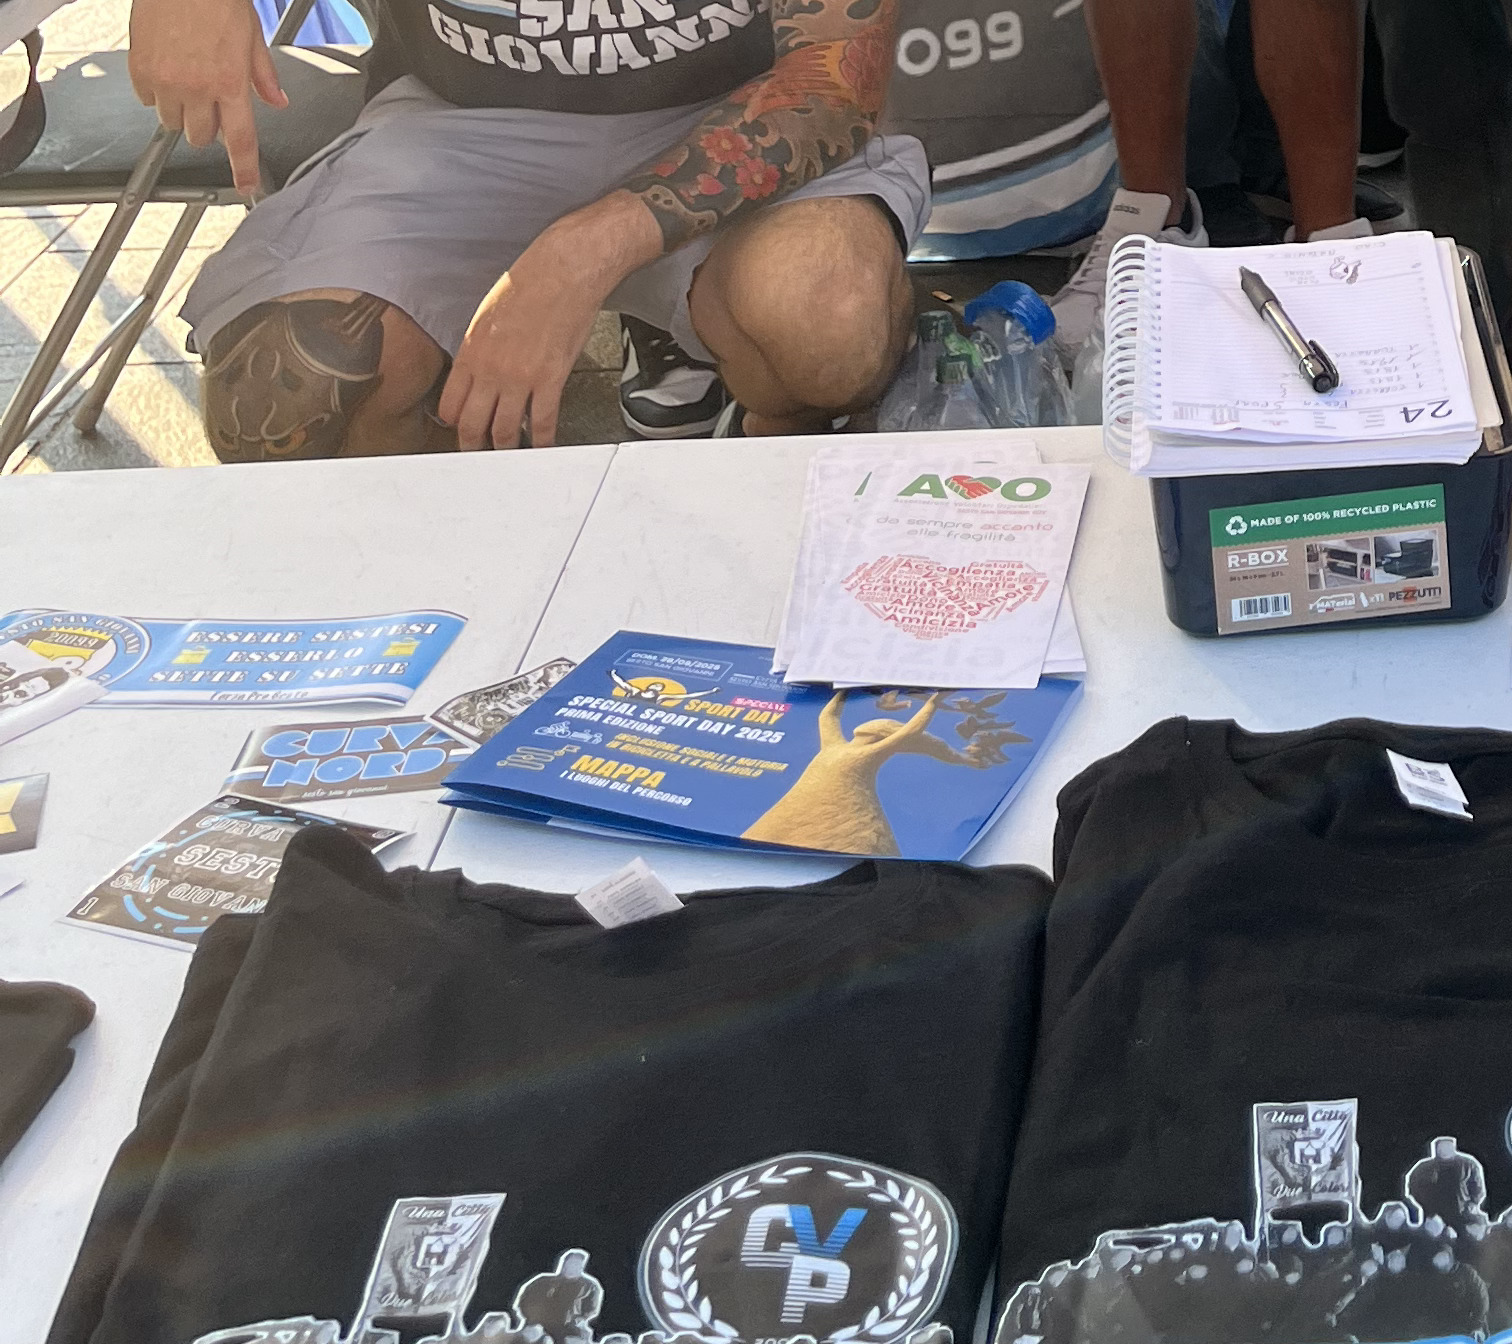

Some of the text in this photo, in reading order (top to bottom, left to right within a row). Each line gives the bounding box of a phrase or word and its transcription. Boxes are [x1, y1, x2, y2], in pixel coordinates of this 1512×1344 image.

[1399, 399, 1453, 424] 24
[906, 517, 974, 533] sempre
[979, 521, 1054, 532] accanto
[1250, 498, 1437, 528] MADE OF 100% RECYCLED PLASTIC
[906, 527, 940, 538] alle
[1227, 548, 1289, 569] R-BOX
[976, 583, 1035, 611] Amore
[184, 622, 440, 644] ESSERE SESTESI
[884, 613, 977, 629] Amicizia
[223, 645, 366, 664] ESSERLO
[148, 661, 411, 683] SETTE SU SETTE
[554, 707, 666, 736] PRIMA EDIZIONE
[567, 695, 786, 745] SPECIAL SPORT DAY 2025
[684, 699, 786, 726] SPORT DAY
[262, 747, 447, 788] NORD
[570, 754, 667, 789] MAPPA
[567, 771, 612, 788] LUOGHI
[609, 780, 630, 794] DEL
[631, 787, 693, 807] PERCORSO
[195, 815, 285, 843] CURVA
[173, 844, 284, 883] SEST
[110, 872, 270, 914] SAN GIOVAN
[740, 1203, 869, 1323] CVP
